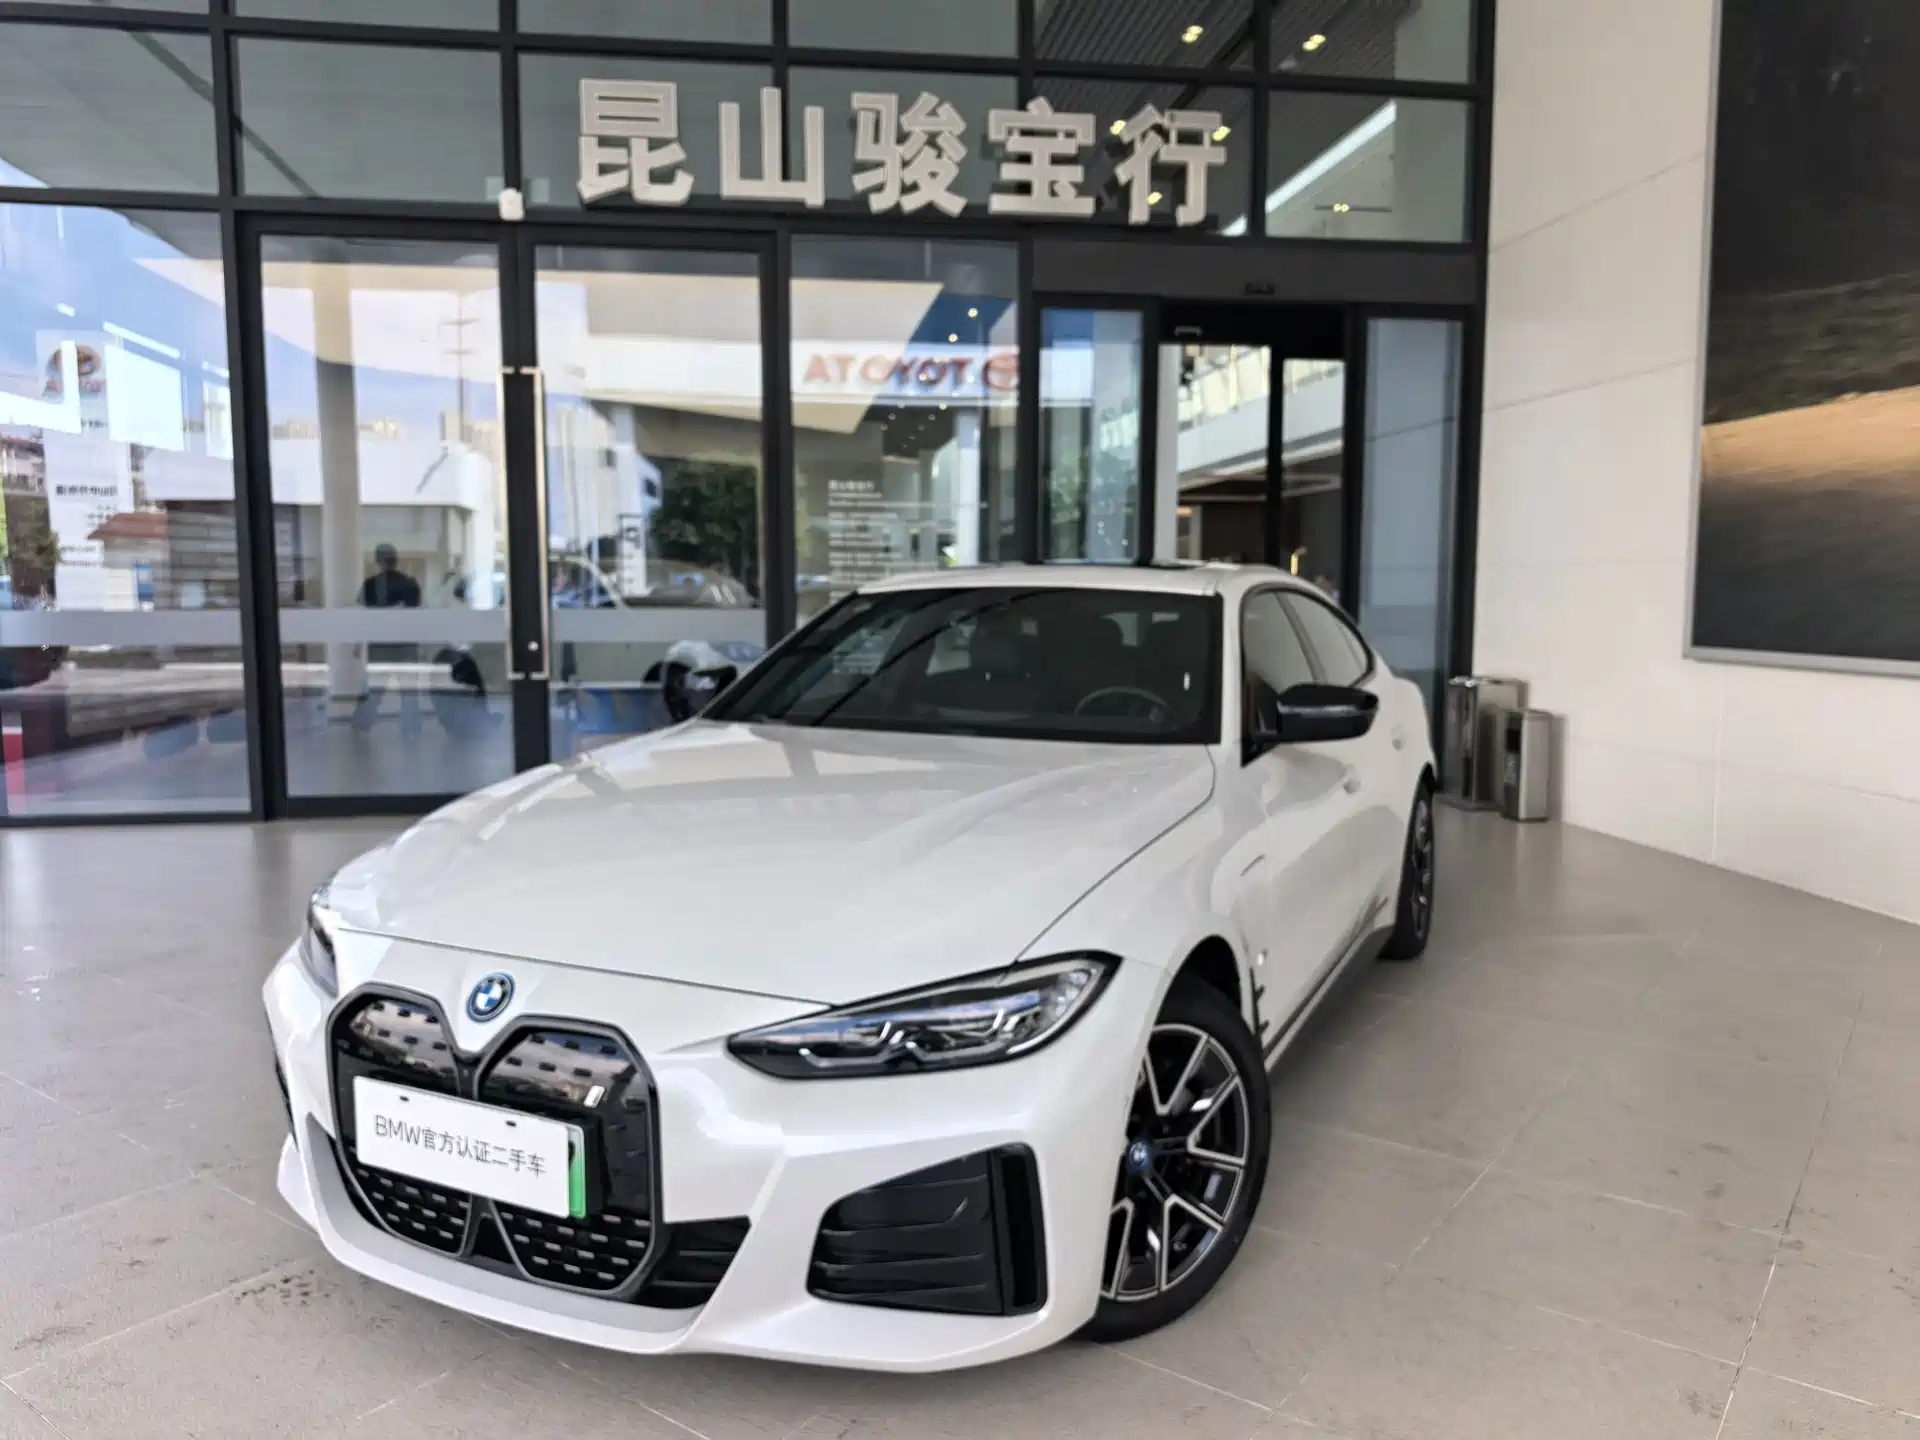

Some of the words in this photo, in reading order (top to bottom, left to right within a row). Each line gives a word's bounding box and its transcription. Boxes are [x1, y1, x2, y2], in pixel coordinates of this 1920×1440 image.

[576, 78, 1228, 227] 昆山骏宝行
[374, 1113, 547, 1177] BMW官方认证二手车
